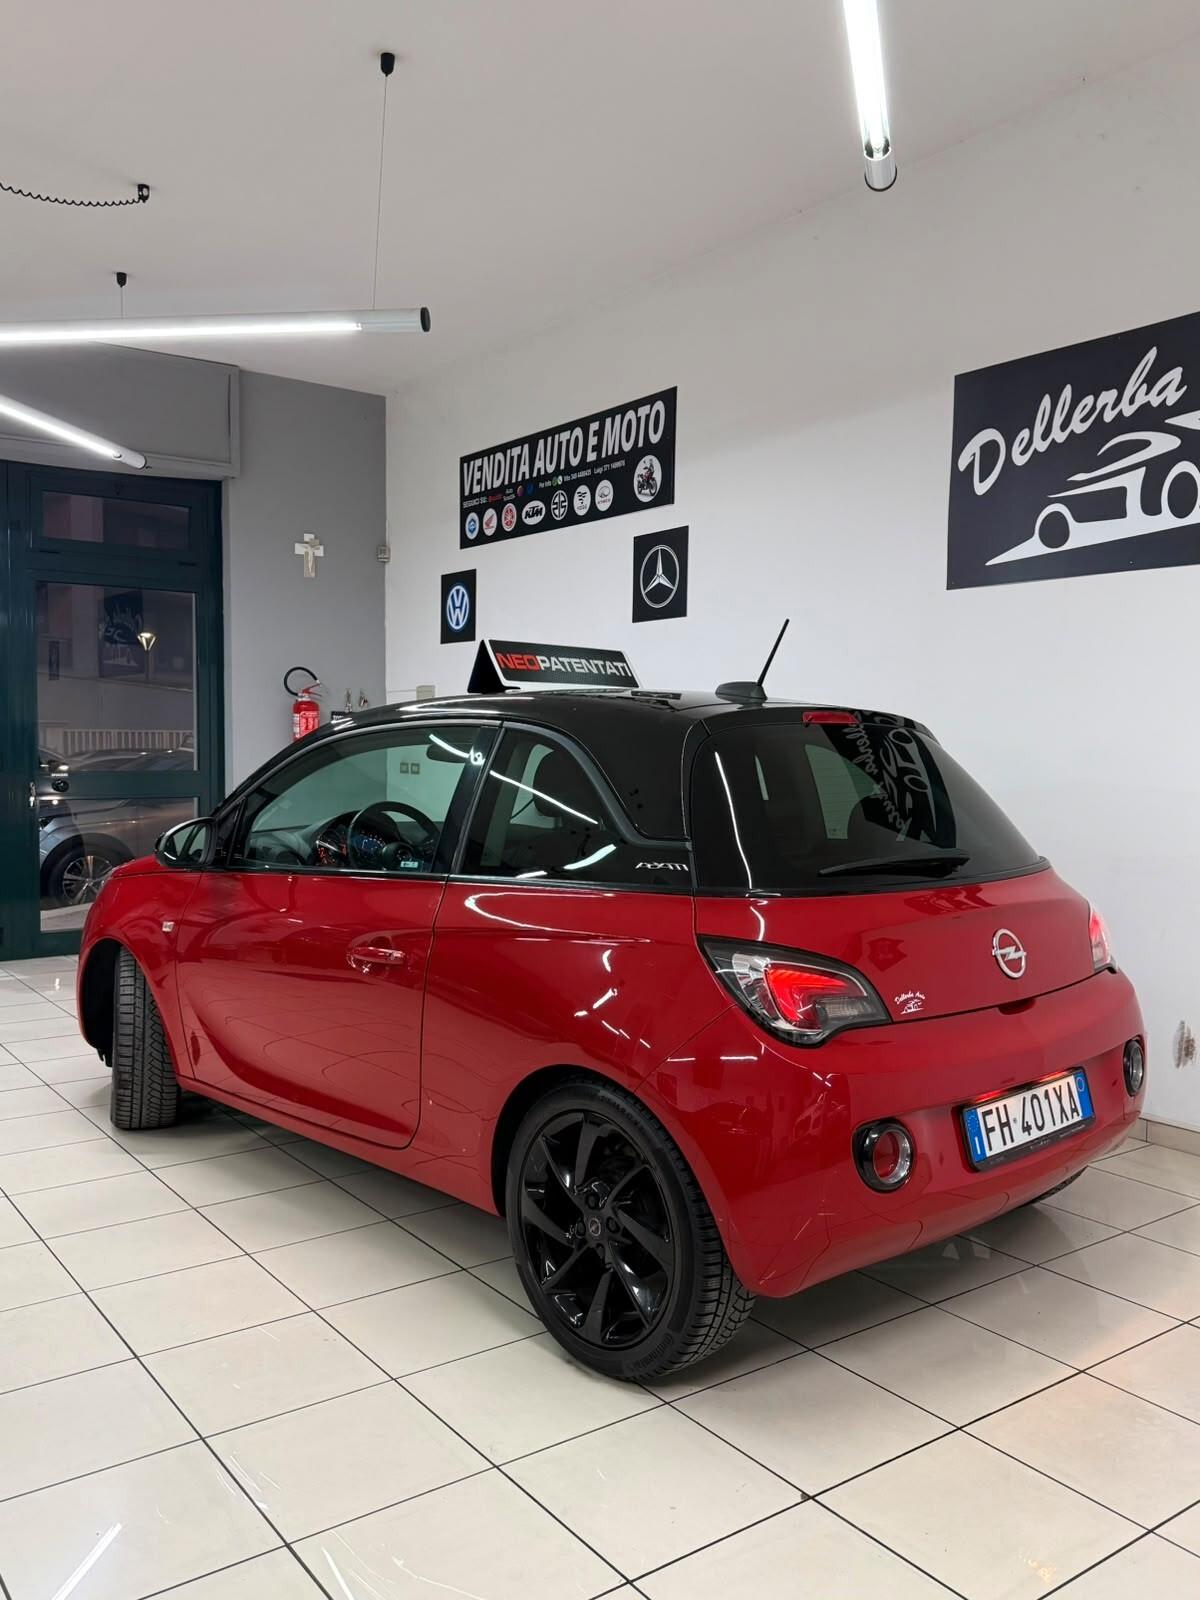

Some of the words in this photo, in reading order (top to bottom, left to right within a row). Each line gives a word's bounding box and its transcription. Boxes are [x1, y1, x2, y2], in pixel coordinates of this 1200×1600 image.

[463, 443, 530, 496] VENDITA
[532, 427, 584, 478] AUTO
[586, 420, 600, 462] E
[601, 400, 666, 458] MOTO
[957, 346, 1188, 496] Dellerba
[524, 504, 544, 520] KTM
[495, 652, 632, 678] NEOPATENTATI
[982, 1104, 1014, 1152] FH
[1021, 1081, 1080, 1136] 401XA
